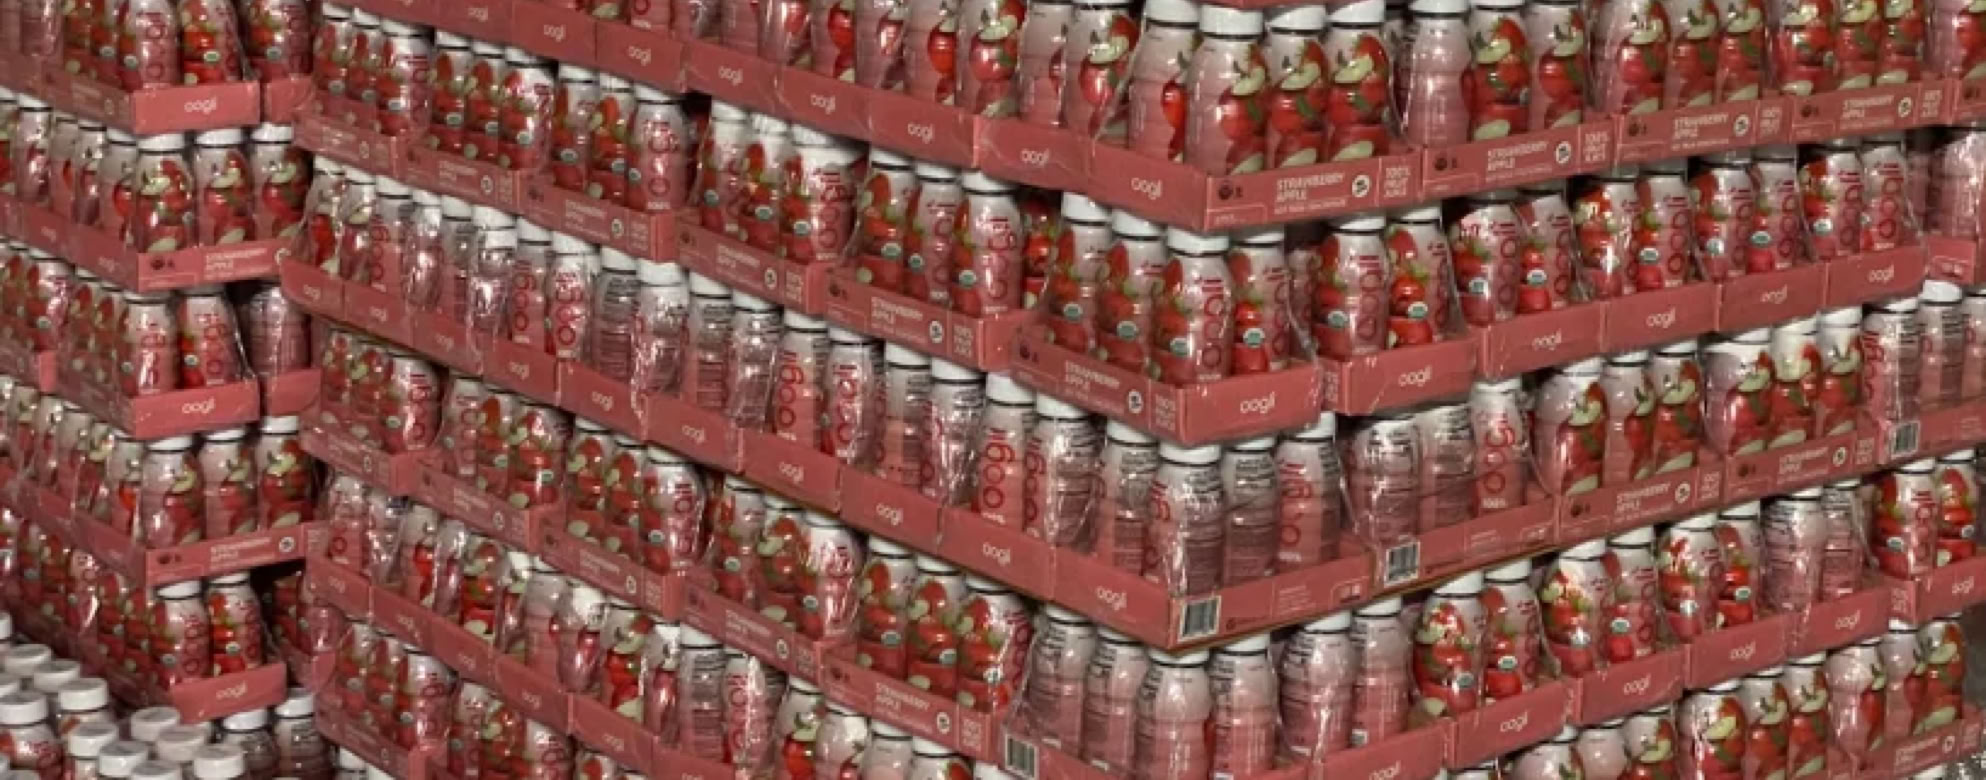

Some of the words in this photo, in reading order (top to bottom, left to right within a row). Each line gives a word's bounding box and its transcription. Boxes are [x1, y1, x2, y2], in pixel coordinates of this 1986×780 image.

[184, 98, 217, 114] oogli
[1131, 177, 1161, 199] oogli
[1277, 173, 1344, 189] STRAWBERRY
[1277, 188, 1306, 202] APPLE
[1646, 307, 1675, 328] oogli
[1532, 329, 1562, 350] oogli
[1399, 366, 1431, 387] oogli
[778, 349, 803, 428] oogli
[182, 399, 215, 414] oogli
[1240, 392, 1275, 414] oogli
[982, 427, 1015, 508] oogli
[876, 504, 902, 525] oogli
[983, 544, 1010, 565] oogli
[1096, 587, 1126, 610] oogli
